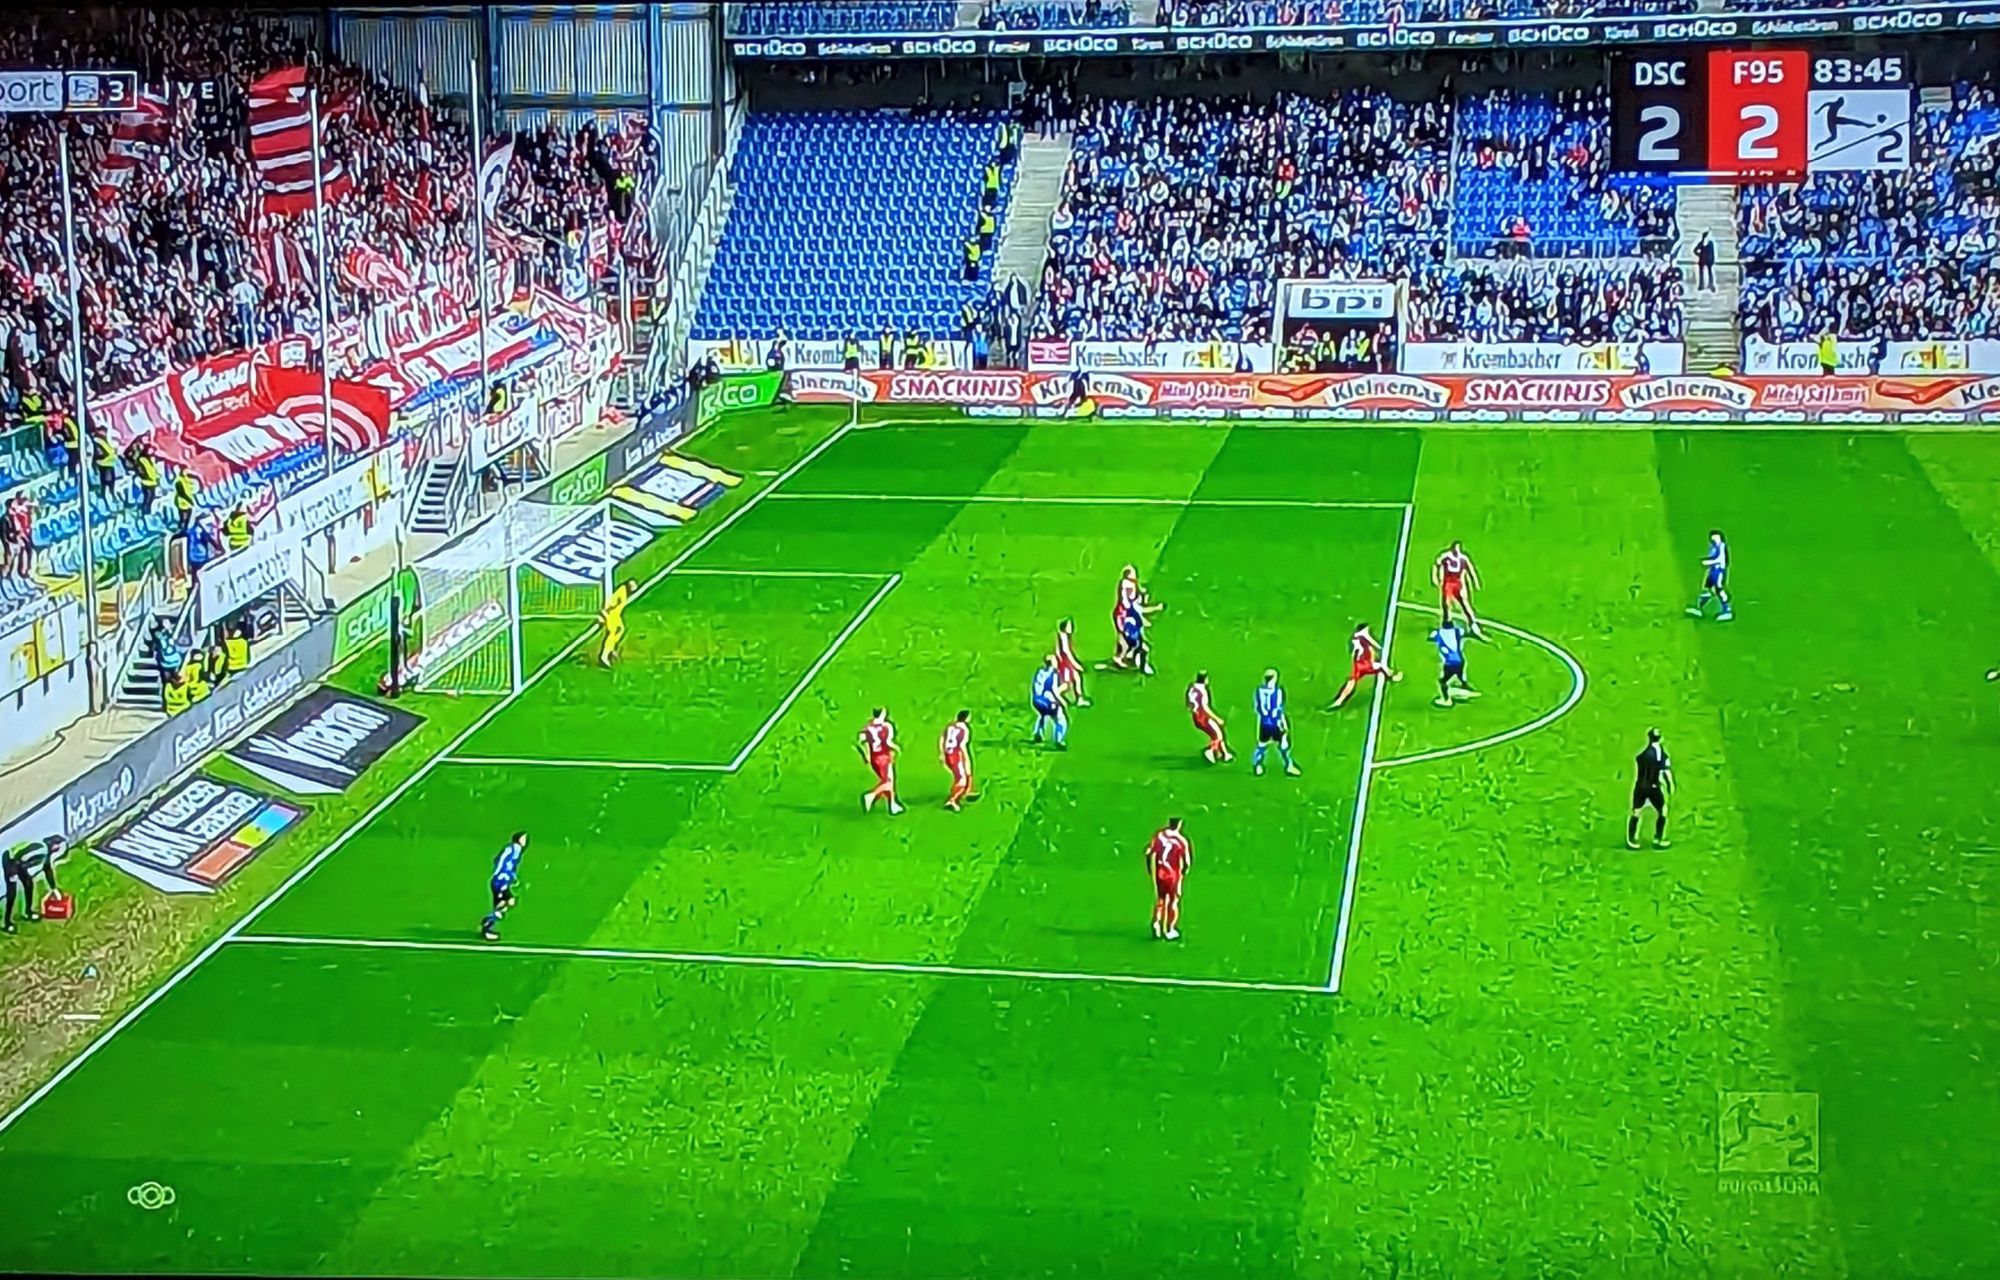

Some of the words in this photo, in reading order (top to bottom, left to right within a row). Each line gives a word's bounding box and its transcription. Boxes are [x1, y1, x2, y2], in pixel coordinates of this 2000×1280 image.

[1635, 62, 1687, 86] DSC
[1733, 60, 1784, 84] F95
[1814, 58, 1902, 83] 83:45
[108, 80, 125, 102] 3
[1638, 105, 1681, 161] 2
[1738, 105, 1780, 160] 2
[1877, 130, 1904, 163] 2
[1463, 345, 1562, 369] Krombacher
[892, 377, 1022, 399] SNACKINIS
[1332, 379, 1443, 404] Kleinemas
[1469, 381, 1608, 401] SNACKINIS
[1629, 380, 1747, 406] Kleinemas
